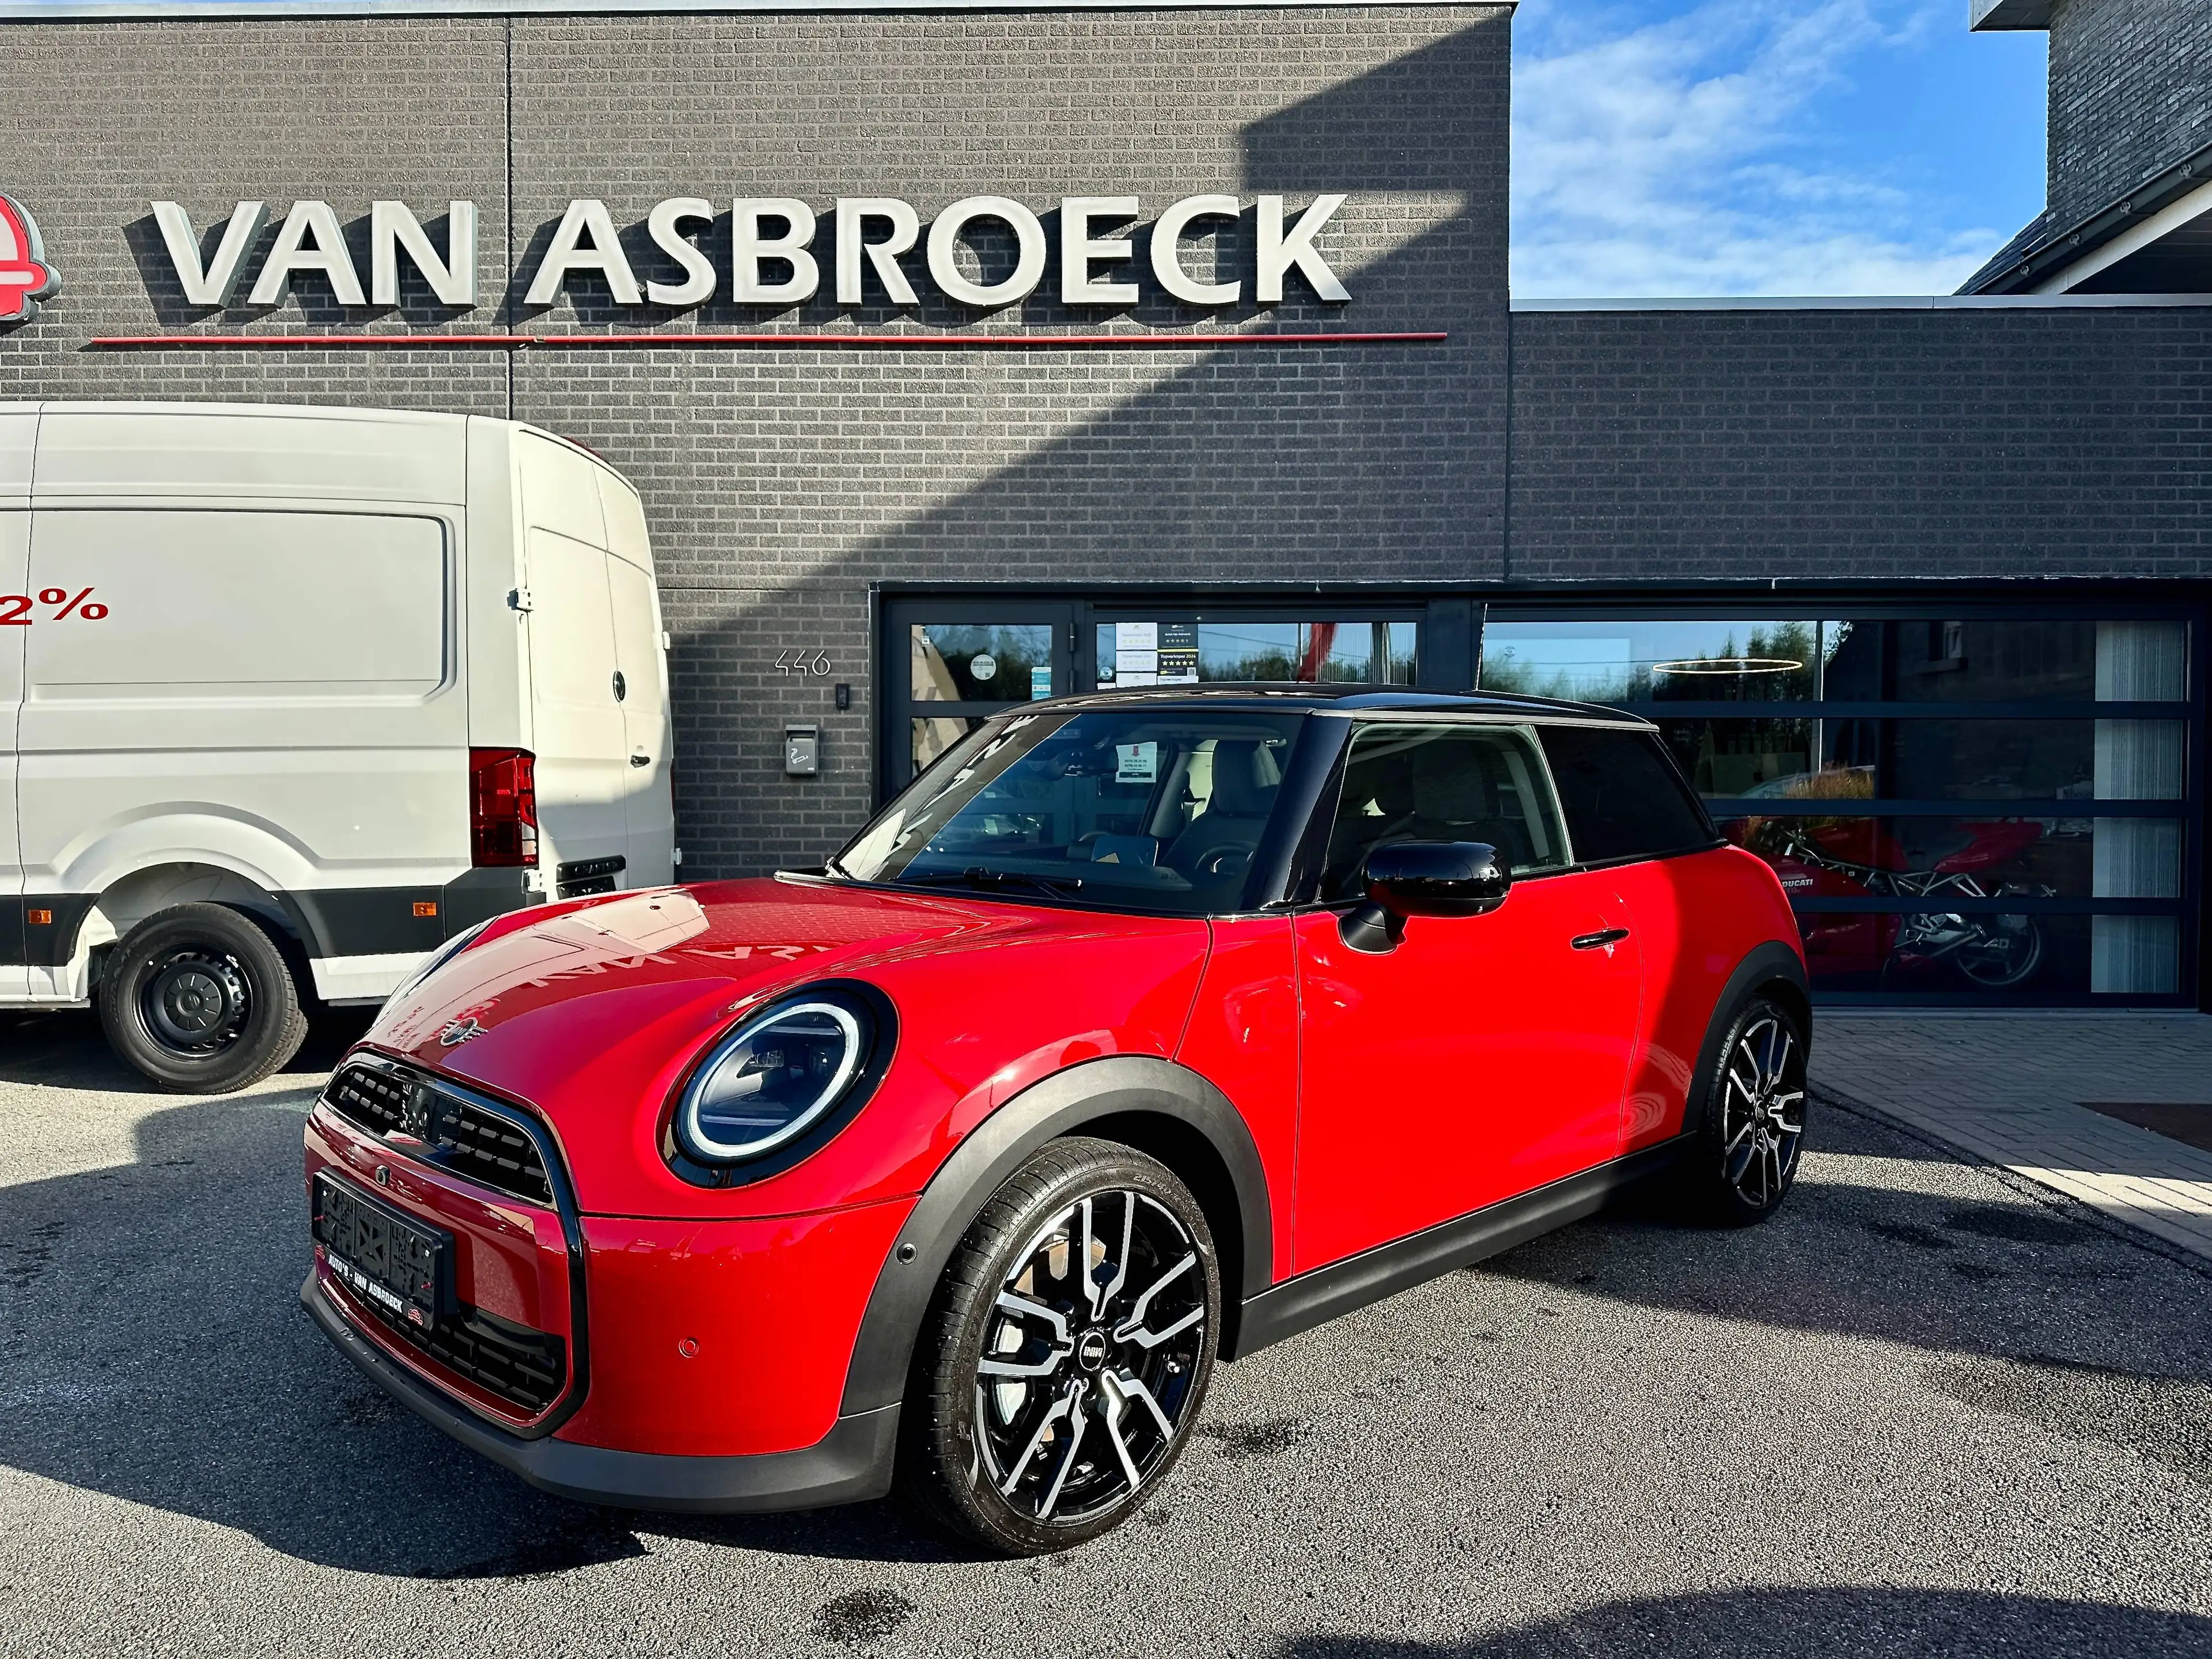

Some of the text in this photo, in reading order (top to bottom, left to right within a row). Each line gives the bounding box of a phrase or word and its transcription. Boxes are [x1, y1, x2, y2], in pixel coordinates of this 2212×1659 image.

[150, 194, 1353, 308] VAN ASBROECK
[0, 587, 108, 626] 2%
[775, 650, 831, 676] 446
[1782, 879, 1813, 887] DUCATI
[328, 1254, 349, 1277] AUTO'S
[354, 1271, 368, 1290] VAN
[368, 1282, 403, 1313] ASBROECK
[1084, 1346, 1103, 1357] MINI
